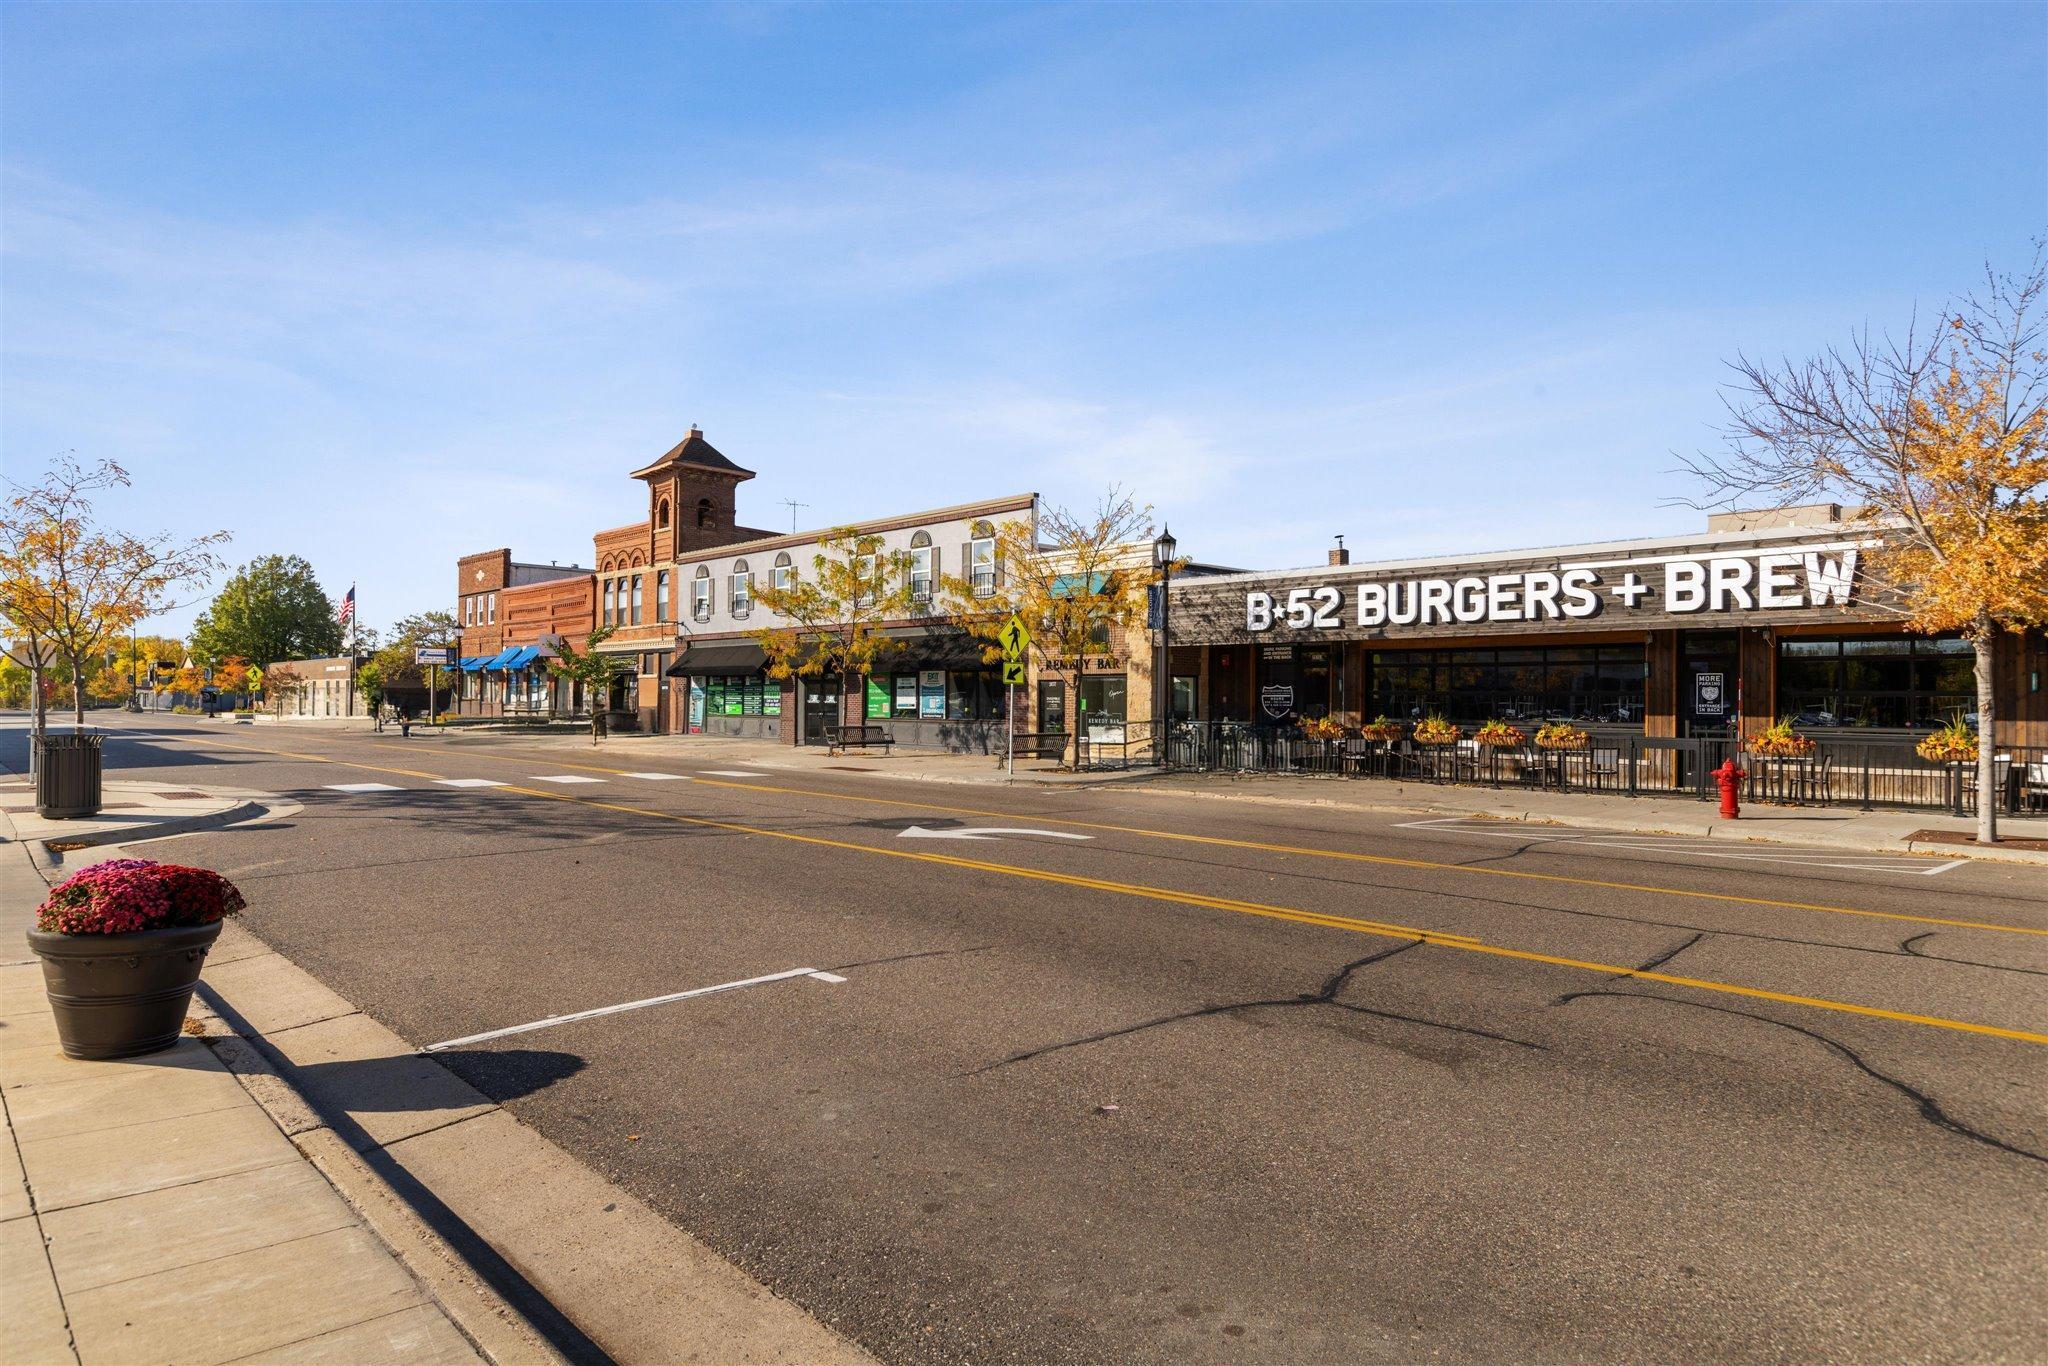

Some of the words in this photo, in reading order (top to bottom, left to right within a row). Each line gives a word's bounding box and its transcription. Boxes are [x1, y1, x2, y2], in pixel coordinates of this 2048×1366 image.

[1358, 569, 1597, 626] BURGERS
[1611, 573, 1648, 607] +
[1665, 550, 1857, 612] BREW
[1098, 659, 1120, 669] BAR
